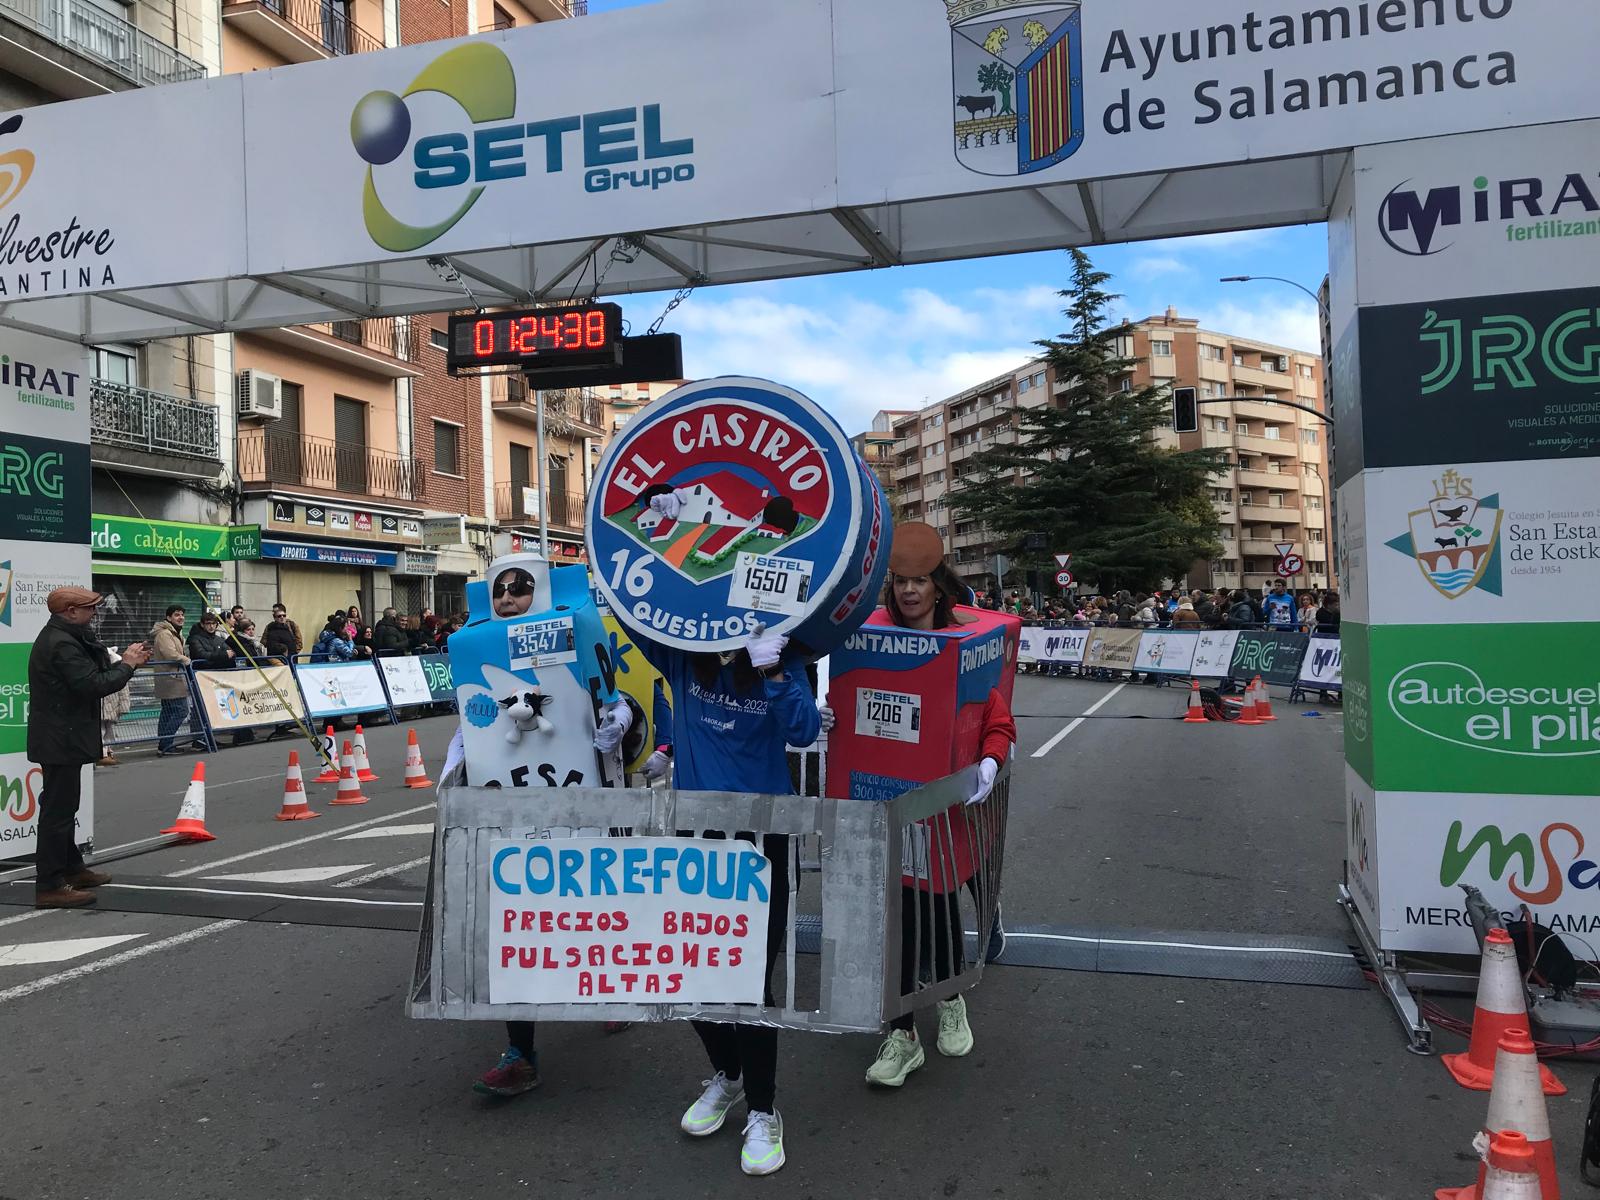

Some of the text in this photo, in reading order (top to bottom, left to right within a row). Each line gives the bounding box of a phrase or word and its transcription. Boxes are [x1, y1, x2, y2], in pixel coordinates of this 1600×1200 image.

[1099, 0, 1513, 80] Ayuntamiento
[1102, 49, 1516, 135] de Salamanca
[414, 103, 693, 189] SETEL
[584, 163, 695, 193] Grupo
[1388, 172, 1600, 255] MiRA
[1506, 219, 1600, 241] fertilizan
[18, 388, 75, 411] fertilizantes
[1508, 415, 1557, 429] VISUALES
[1560, 416, 1567, 424] A
[613, 454, 666, 496] EL
[331, 514, 349, 525] FILA
[1509, 511, 1545, 521] Colegio
[1547, 510, 1580, 520] Jesuita
[403, 522, 418, 532] FILA
[1509, 523, 1600, 541] San Esta
[134, 528, 199, 552] calzados
[231, 545, 257, 557] Verde
[233, 534, 254, 546] Club
[281, 546, 377, 564] DEPORTES SAN ANTONIO
[1510, 543, 1534, 561] de
[610, 549, 655, 597] 16
[756, 557, 805, 572] SETEL
[1510, 566, 1538, 576] desde
[15, 580, 34, 592] San
[745, 567, 788, 594] 1550
[15, 593, 28, 605] de
[526, 620, 567, 633] SETEL
[517, 631, 568, 655] 3547
[1232, 635, 1278, 672] JRG
[423, 660, 453, 692] JR
[243, 702, 293, 715] de Salamana
[744, 698, 769, 712] 2023
[873, 691, 915, 704] SETEL
[867, 700, 902, 724] 1206
[1466, 707, 1512, 740] el
[854, 783, 874, 799] 900
[493, 845, 769, 903] CORRE-FOUR
[503, 909, 749, 938] PRECIOS BAJOS
[501, 942, 743, 969] PULSACIONES
[577, 971, 684, 997] ALTAS
